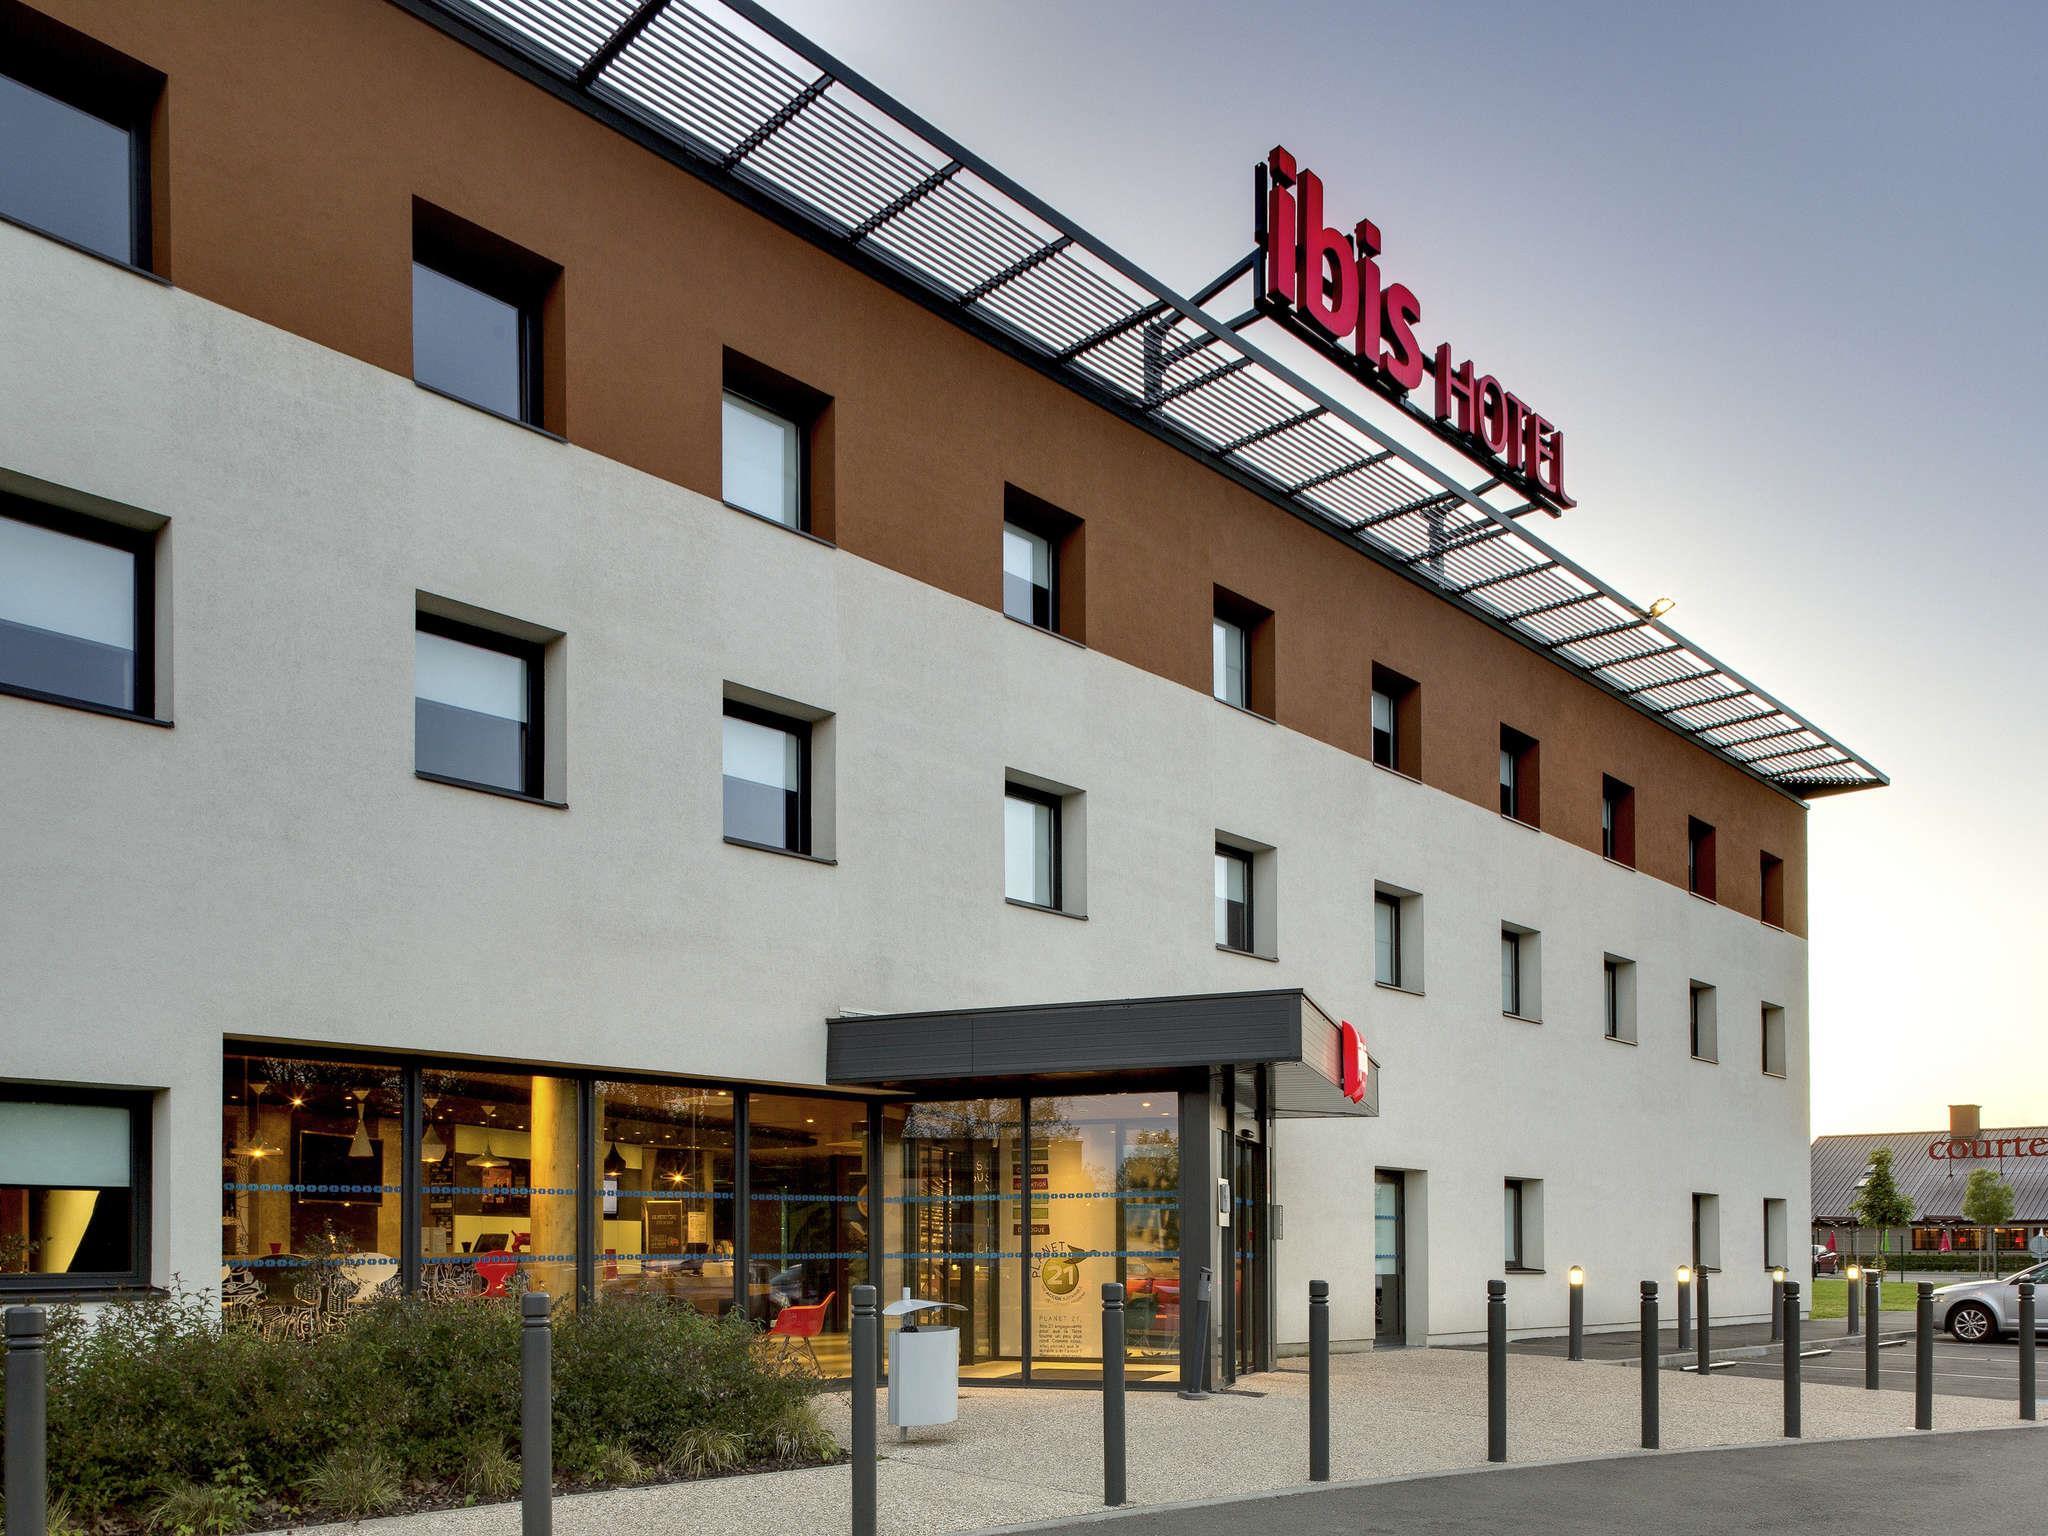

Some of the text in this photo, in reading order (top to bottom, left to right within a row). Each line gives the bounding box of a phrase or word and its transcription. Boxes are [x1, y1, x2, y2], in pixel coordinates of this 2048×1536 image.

[1267, 145, 1577, 508] ibis HOTEL
[1928, 1136, 2048, 1160] courte
[1047, 1265, 1074, 1285] 21
